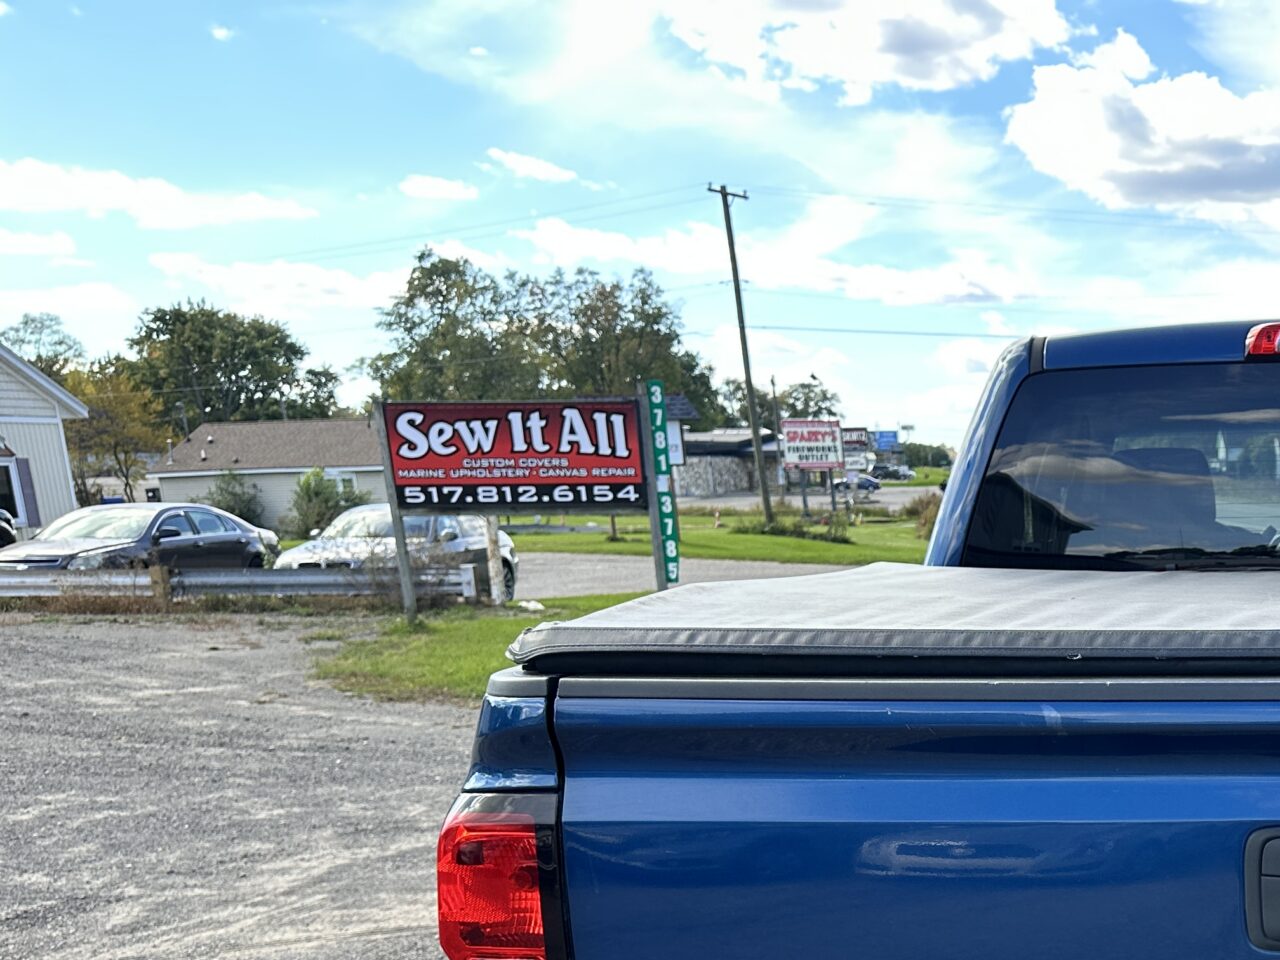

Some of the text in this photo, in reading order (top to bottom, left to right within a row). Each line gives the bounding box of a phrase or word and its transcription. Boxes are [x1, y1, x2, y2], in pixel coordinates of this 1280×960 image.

[395, 407, 631, 460] Sew It All
[786, 430, 838, 443] SPARKY'S
[787, 445, 838, 454] FIREWORKS
[462, 458, 569, 468] CUSTOM COVERS
[398, 467, 636, 478] MARINE UPHOLSTERY CANVAS REPAIR
[404, 484, 640, 504] 517.812.6154
